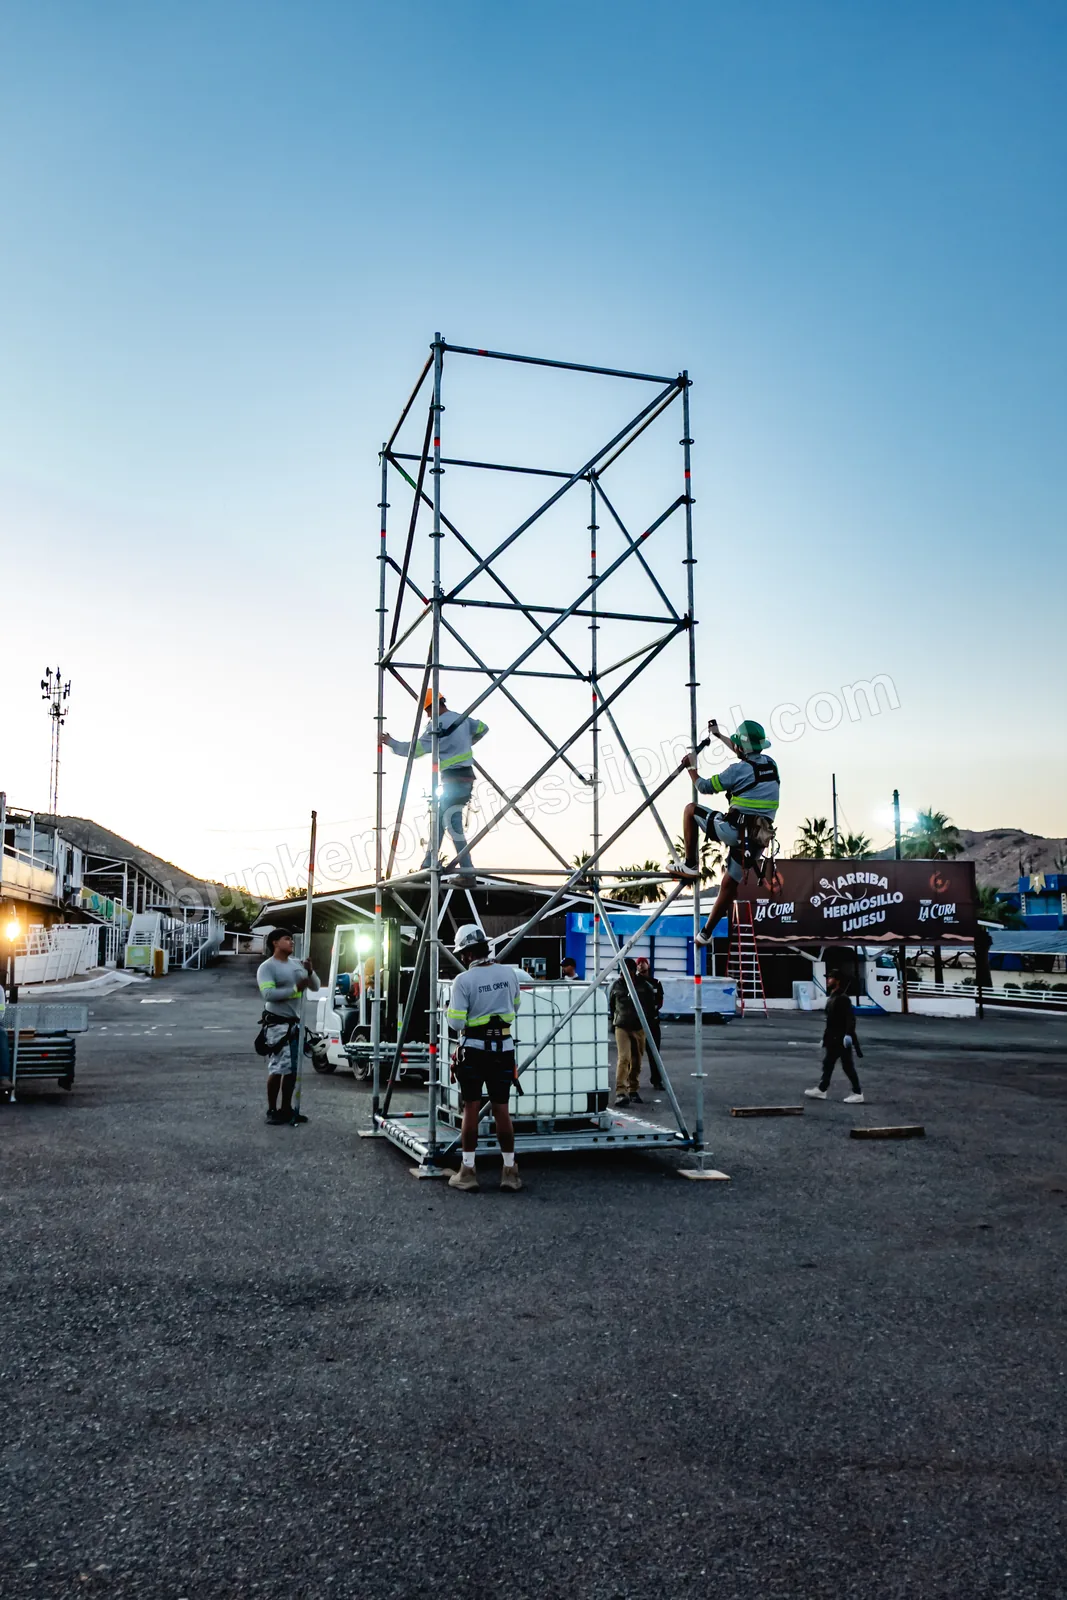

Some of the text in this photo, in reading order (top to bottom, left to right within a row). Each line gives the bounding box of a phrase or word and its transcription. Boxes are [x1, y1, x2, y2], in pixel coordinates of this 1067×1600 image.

[837, 872, 888, 889] ARRIBA
[754, 902, 795, 921] LA CURA
[823, 892, 904, 918] HERMOSILLO
[918, 903, 956, 922] LA CURA
[842, 910, 886, 932] IJUESU
[478, 981, 508, 993] STEEL CREW
[883, 984, 891, 996] 8
